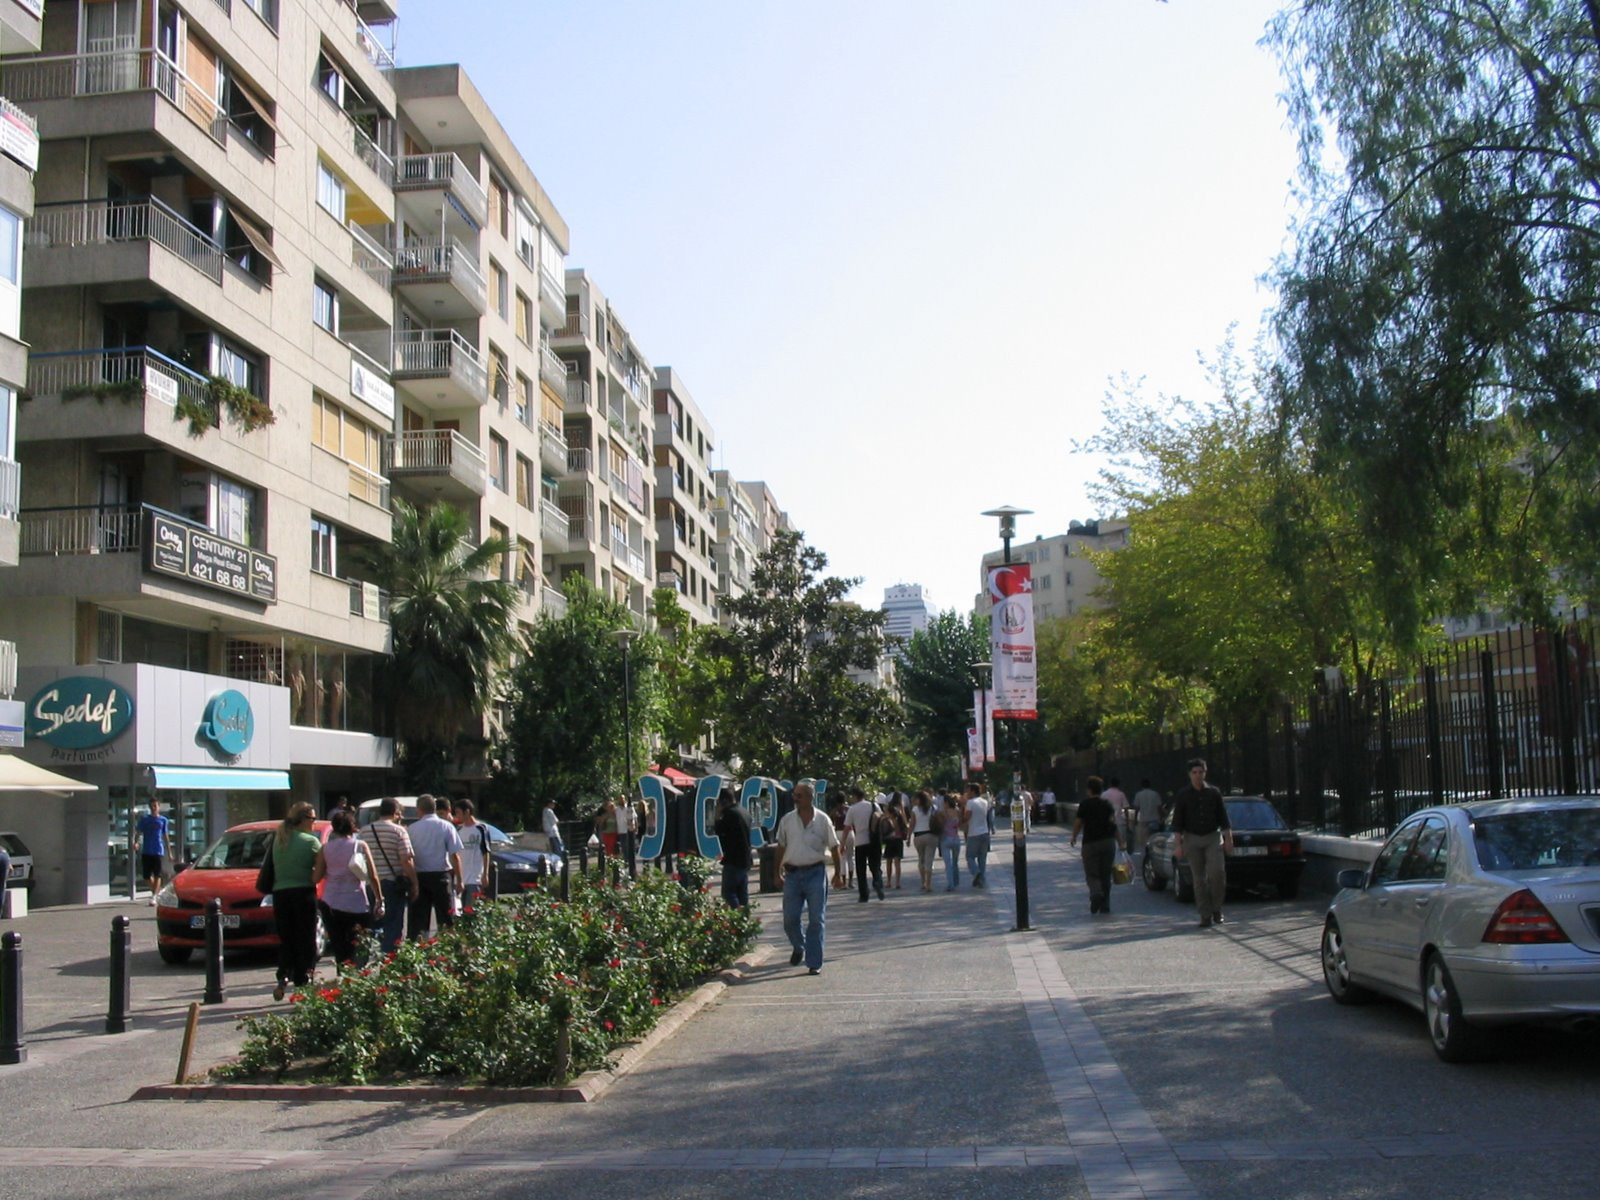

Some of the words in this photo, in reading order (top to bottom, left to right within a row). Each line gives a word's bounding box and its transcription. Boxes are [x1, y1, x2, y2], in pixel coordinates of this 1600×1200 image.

[192, 535, 237, 560] CENTURY
[237, 551, 248, 564] 21
[192, 563, 213, 580] 421
[216, 569, 231, 585] 68
[232, 574, 247, 590] 68
[34, 689, 118, 736] Sedef
